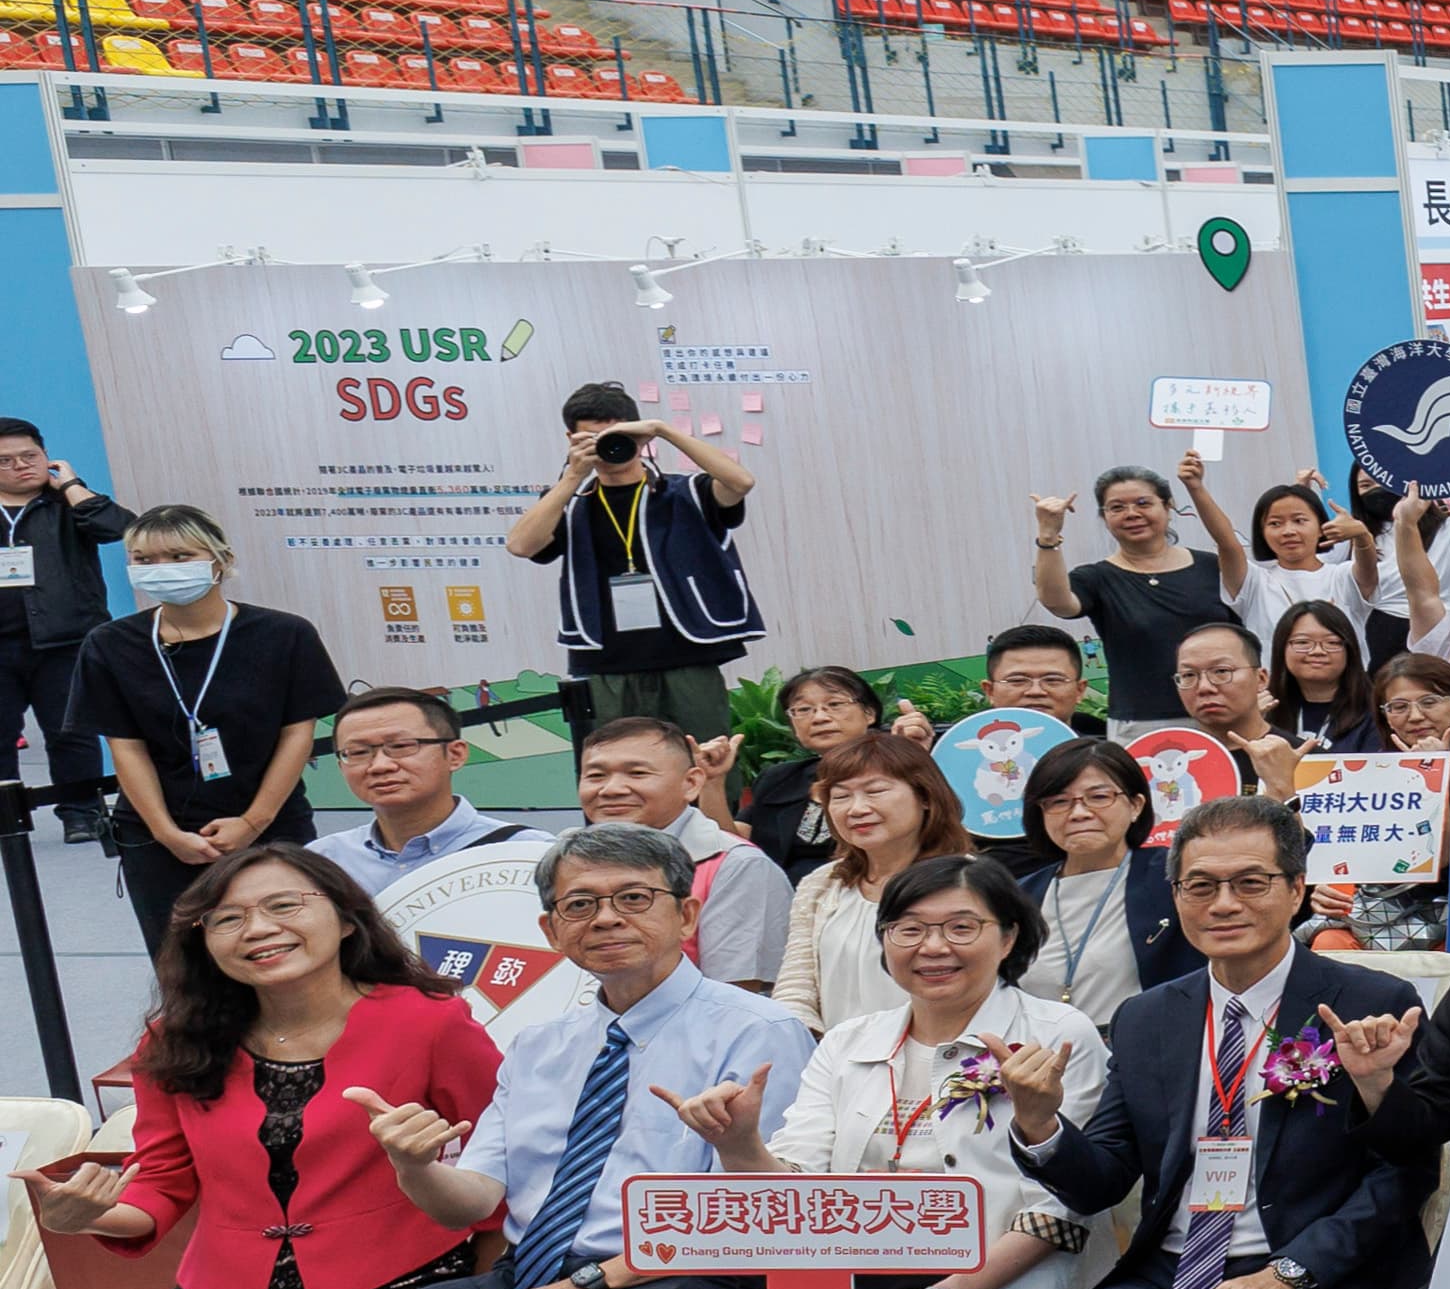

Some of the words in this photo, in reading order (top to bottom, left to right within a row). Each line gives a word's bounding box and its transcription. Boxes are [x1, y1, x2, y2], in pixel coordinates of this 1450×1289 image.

[288, 328, 391, 364] 2023
[400, 328, 491, 363] USR
[336, 376, 468, 421] SDGs
[1348, 423, 1393, 487] NATIONAL
[391, 869, 535, 929] UNIVERSIT
[437, 949, 473, 979] 理
[1205, 1171, 1237, 1182] VVIP
[639, 1188, 970, 1236] 長庚科技大學
[682, 1246, 719, 1258] Chang
[723, 1246, 753, 1258] Gung
[756, 1245, 818, 1257] University
[821, 1245, 832, 1256] of
[835, 1246, 880, 1256] Science
[882, 1246, 903, 1256] and
[907, 1246, 972, 1258] Technology
